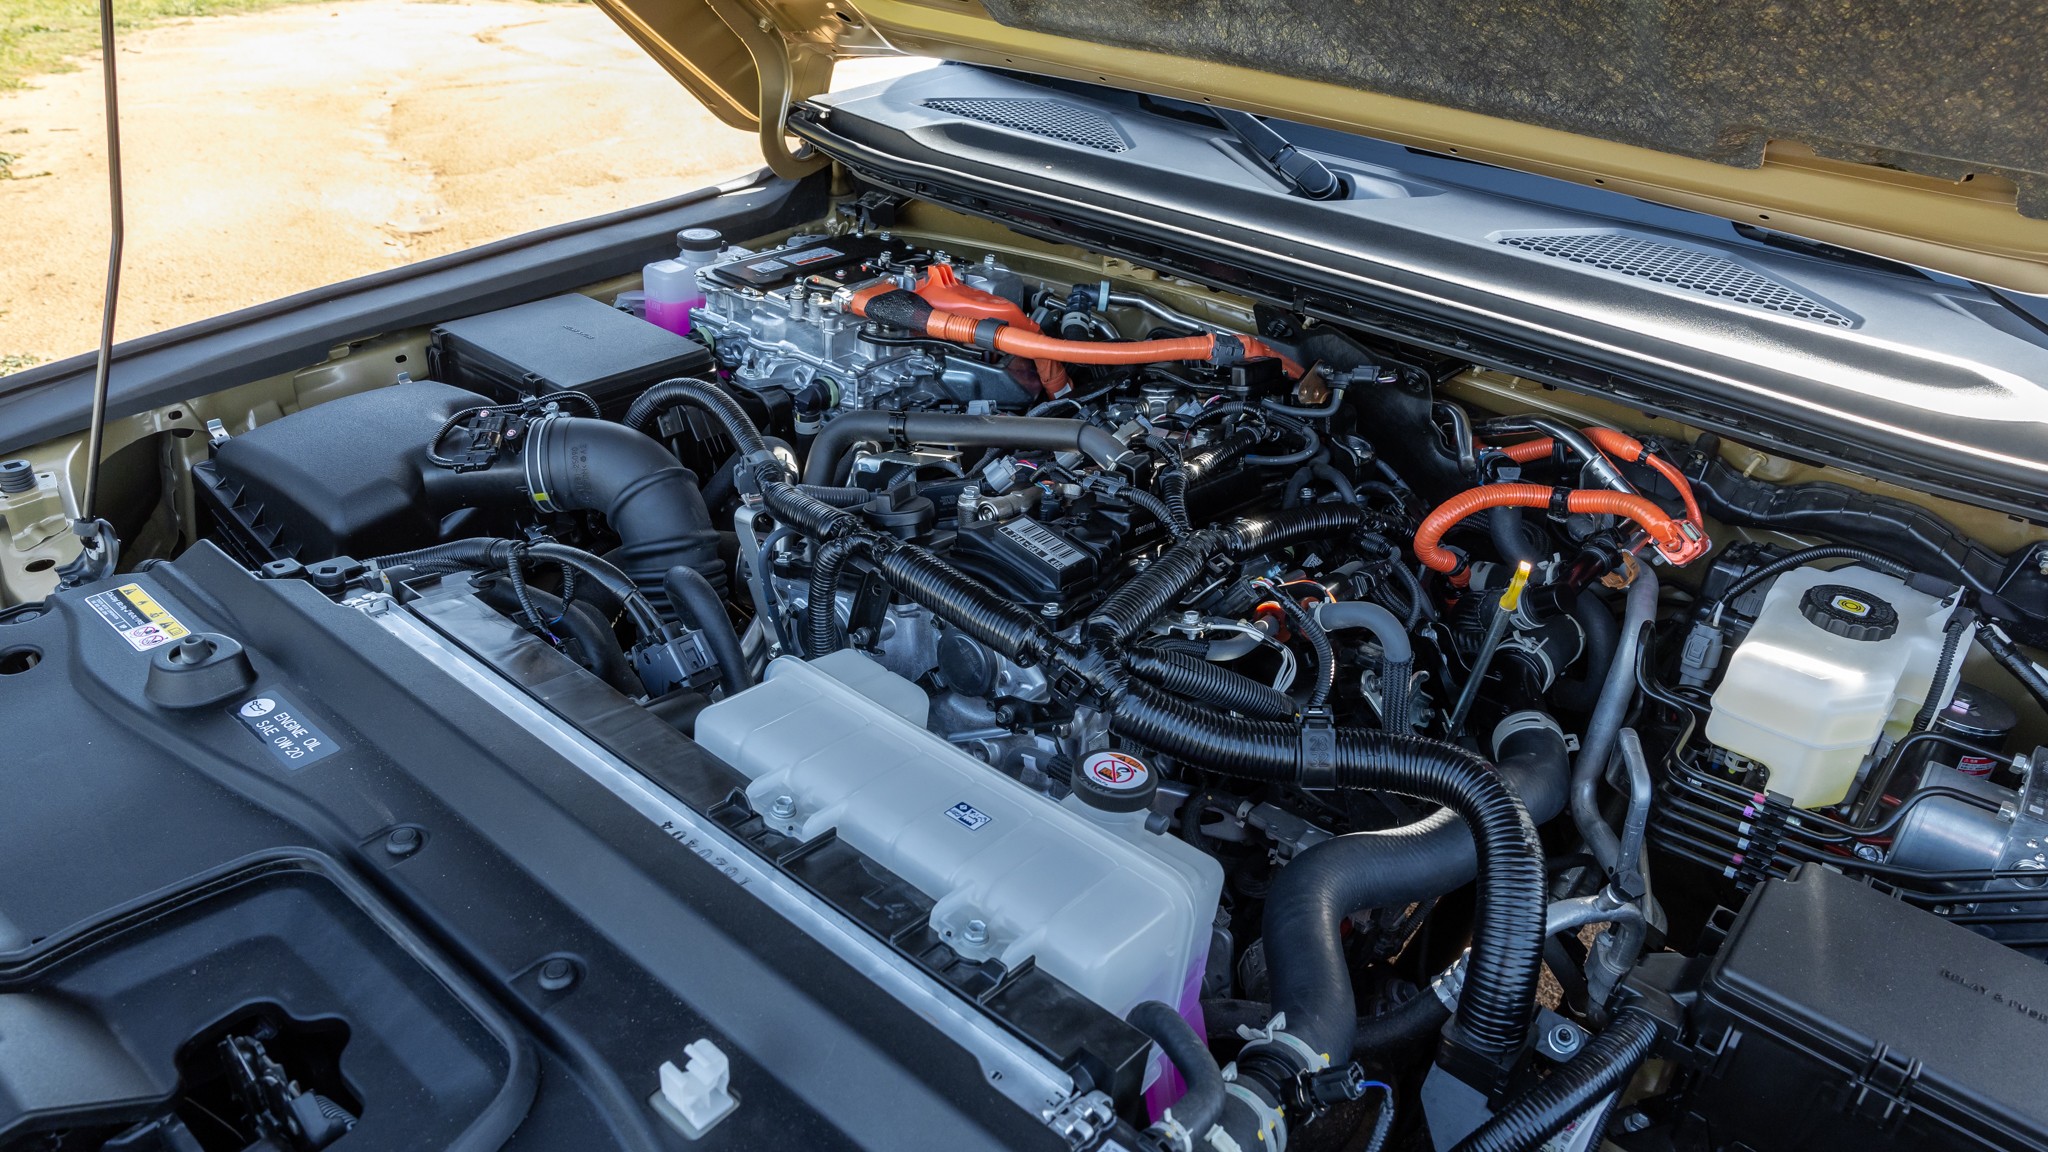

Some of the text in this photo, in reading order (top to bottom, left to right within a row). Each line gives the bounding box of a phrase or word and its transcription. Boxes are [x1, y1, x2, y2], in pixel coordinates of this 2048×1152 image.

[255, 719, 305, 759] SAE 0W-20
[273, 711, 322, 752] ENGINE OIL
[1940, 968, 1990, 995] RELAY
